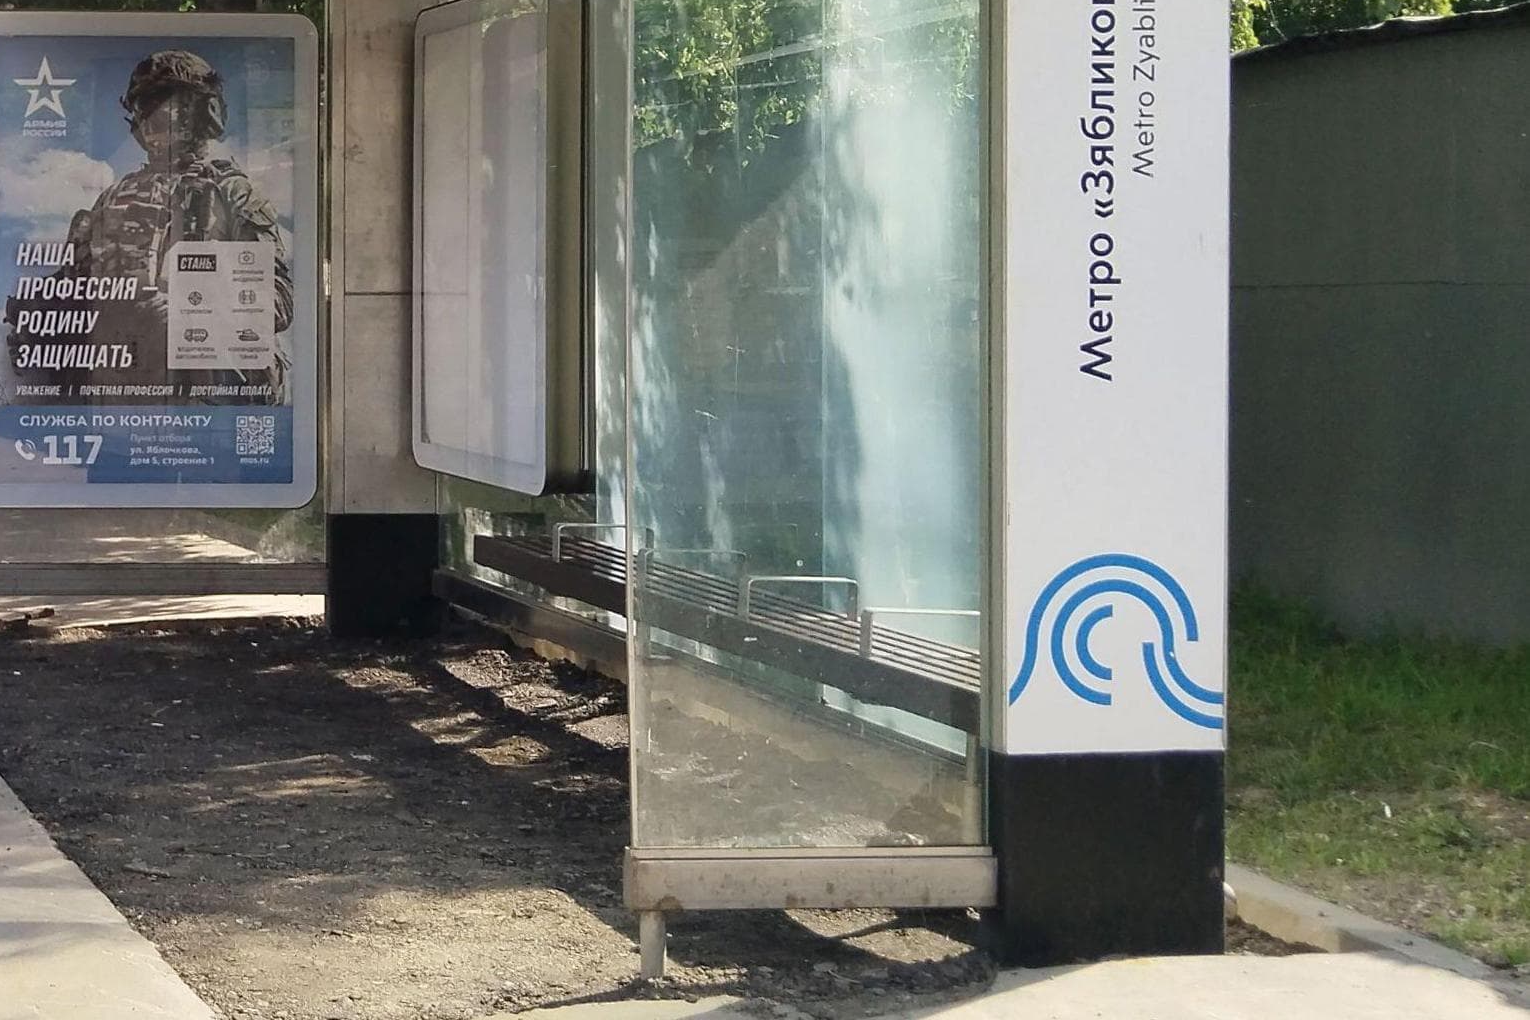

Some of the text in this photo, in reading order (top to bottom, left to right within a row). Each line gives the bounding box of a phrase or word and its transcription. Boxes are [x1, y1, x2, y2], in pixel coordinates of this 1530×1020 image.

[1131, 90, 1155, 178] Metro
[16, 242, 75, 267] НАША
[180, 257, 215, 270] СТАНЬ:
[16, 276, 139, 301] ПРОФЕССИЯ
[1079, 232, 1122, 382] Метро
[16, 310, 100, 337] РОДИНУ
[16, 344, 133, 371] ЗАЩИЩАТЬ
[16, 384, 62, 396] УВАЖЕНИЕ
[79, 384, 174, 396] ПОЧЕТНАЯ ПРОФЕССИЯ
[19, 414, 212, 427] СЛУЖБА ПО КОНТРАКТУ
[42, 434, 103, 466] 117
